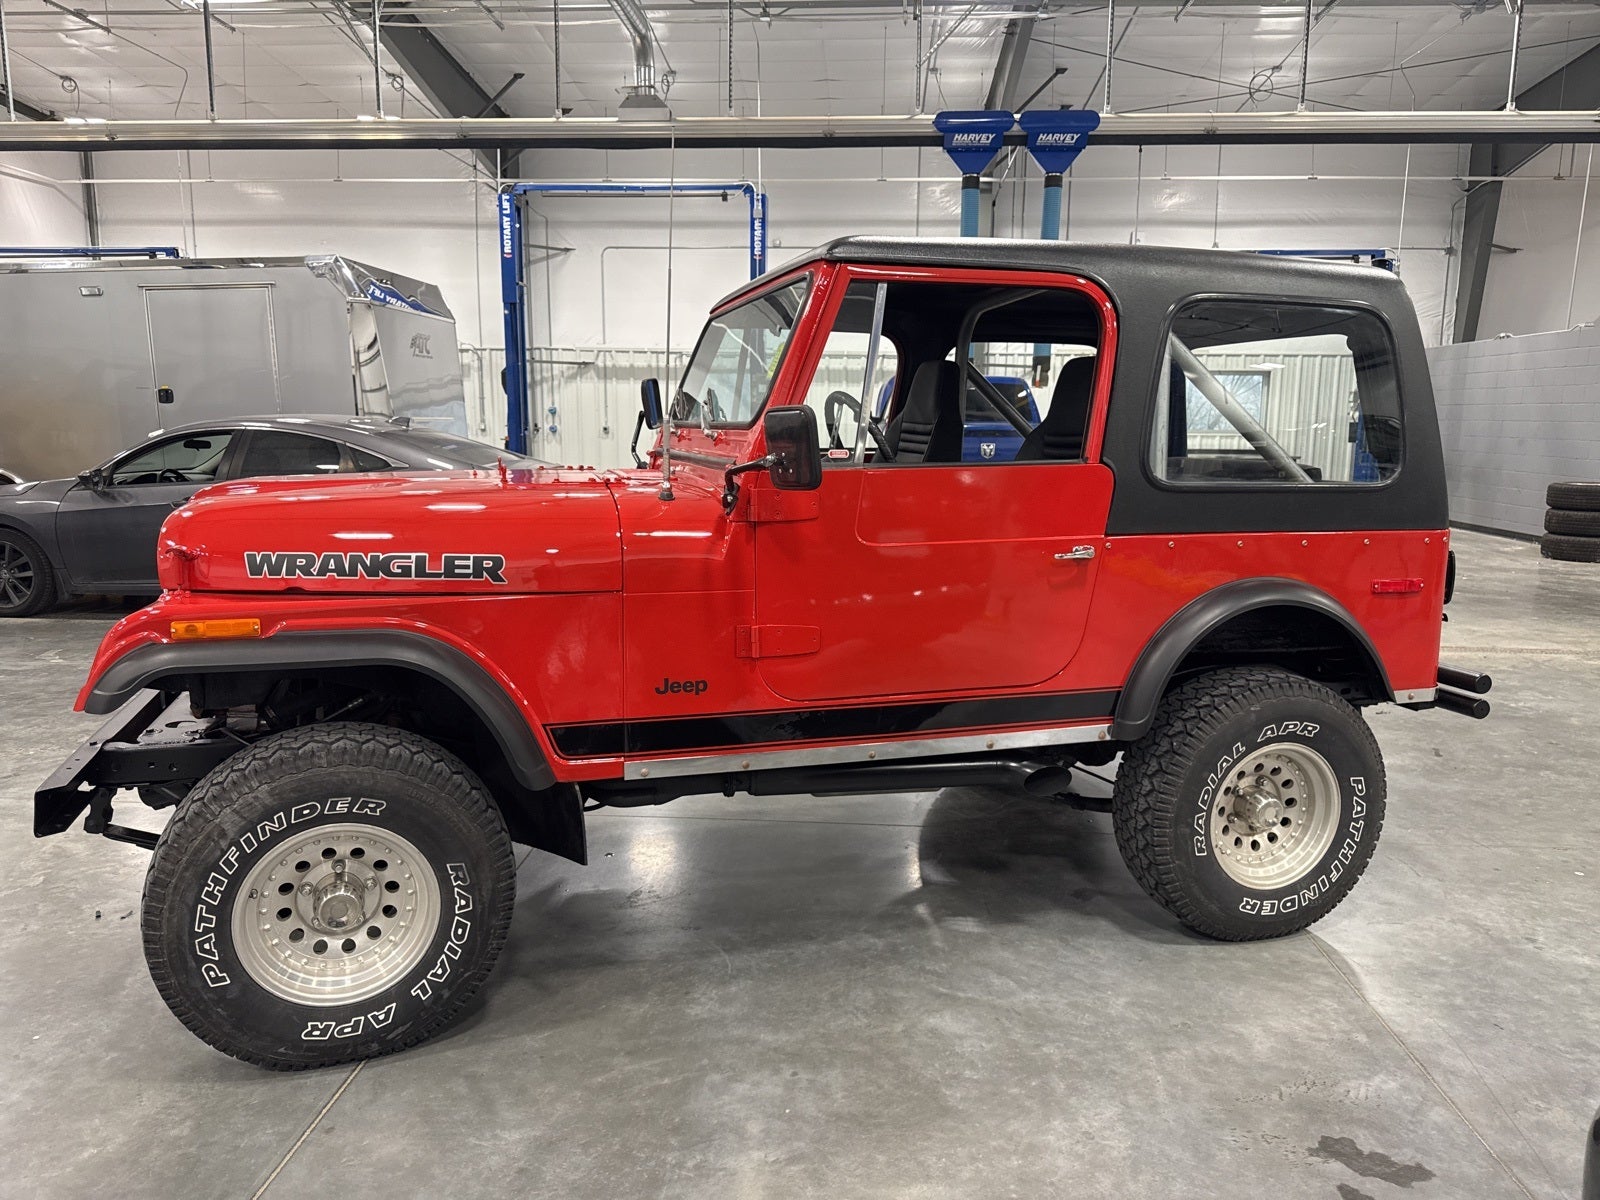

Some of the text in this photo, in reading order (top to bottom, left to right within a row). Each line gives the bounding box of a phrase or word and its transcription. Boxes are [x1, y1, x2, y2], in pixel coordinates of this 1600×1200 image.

[953, 133, 996, 143] HARVEY
[1037, 133, 1081, 143] HARVEY
[502, 194, 512, 253] ROTARY LIFT
[244, 552, 508, 584] WRANGLER
[654, 677, 708, 696] Jeep
[1194, 721, 1320, 856] RADIAL APR
[1239, 776, 1367, 915] PATHFINDER
[195, 797, 387, 987] PATHFINDER
[301, 862, 473, 1040] RADIAL APR
